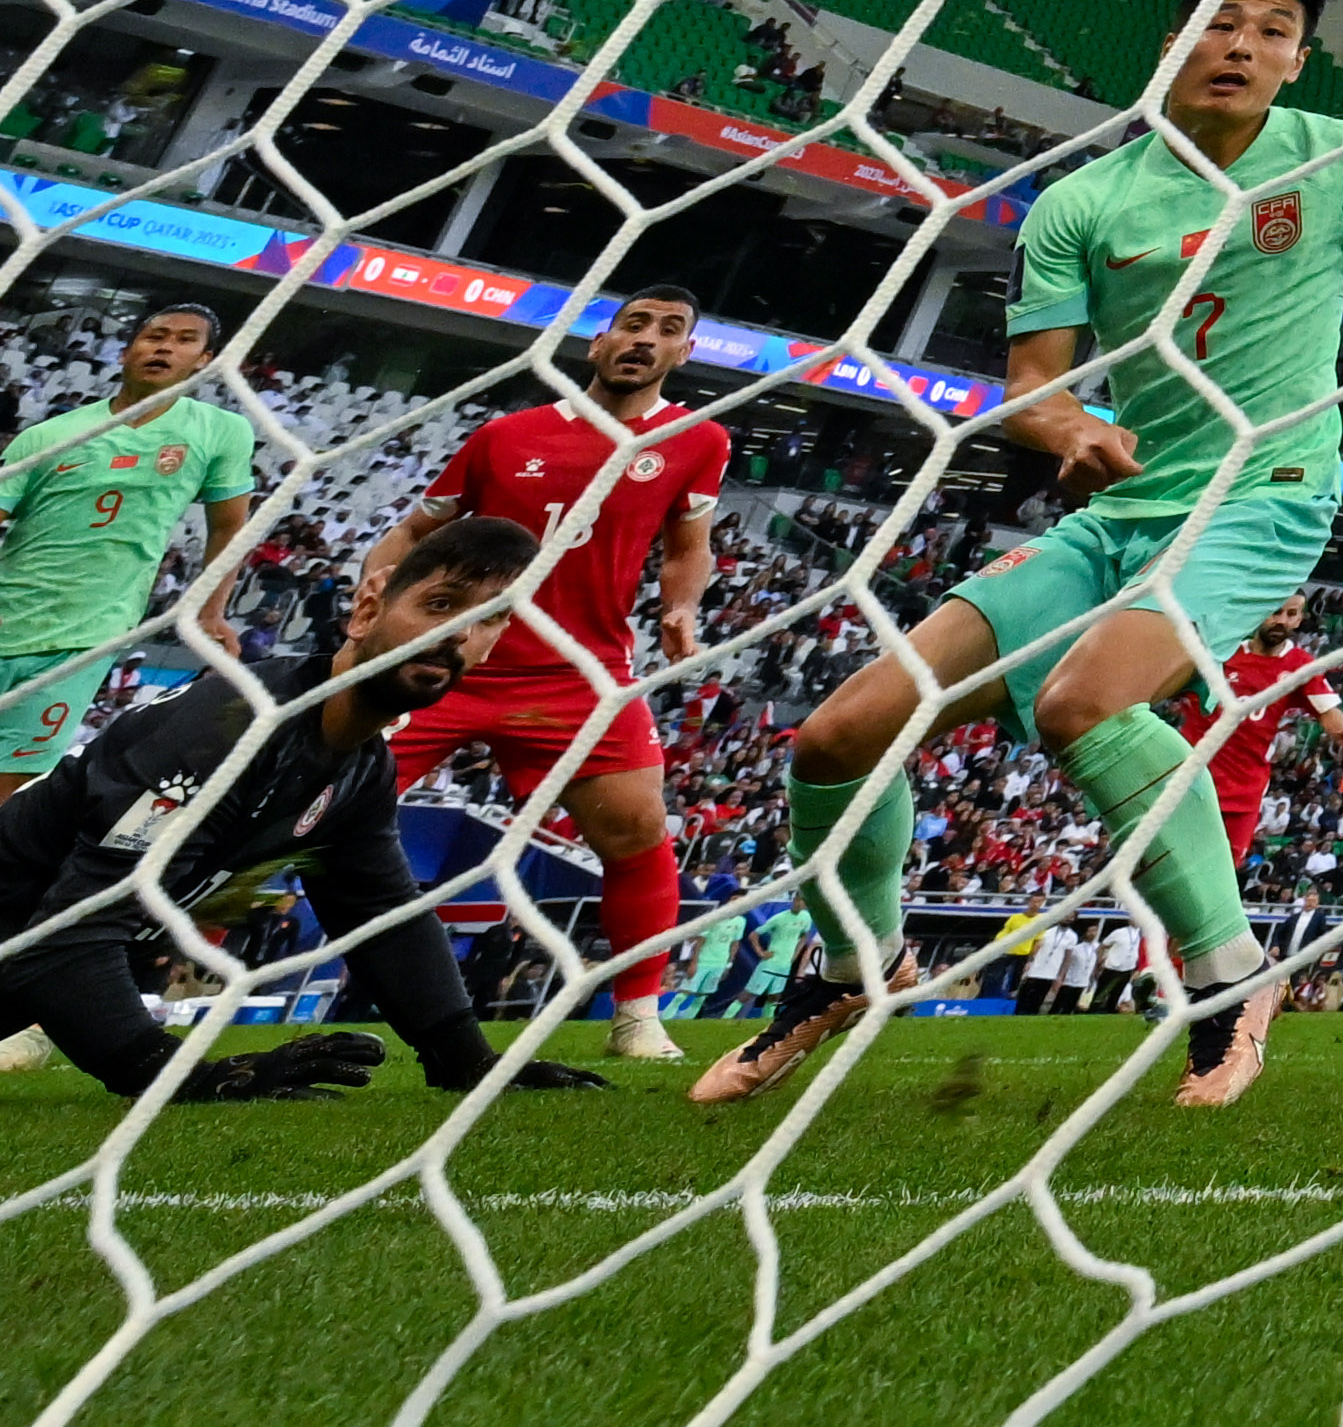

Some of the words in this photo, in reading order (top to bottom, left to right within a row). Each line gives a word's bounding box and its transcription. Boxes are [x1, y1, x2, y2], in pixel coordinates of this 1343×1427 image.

[108, 212, 141, 231] CUP
[1257, 198, 1296, 215] CFA
[363, 257, 386, 282] 0
[464, 278, 485, 303] 0
[482, 287, 517, 306] CHN
[1182, 292, 1226, 361] 7
[833, 362, 860, 380] LBN
[856, 366, 872, 387] 0
[930, 380, 946, 403] 0
[943, 387, 971, 403] CHN
[88, 489, 124, 529] 9
[32, 701, 70, 742] 9
